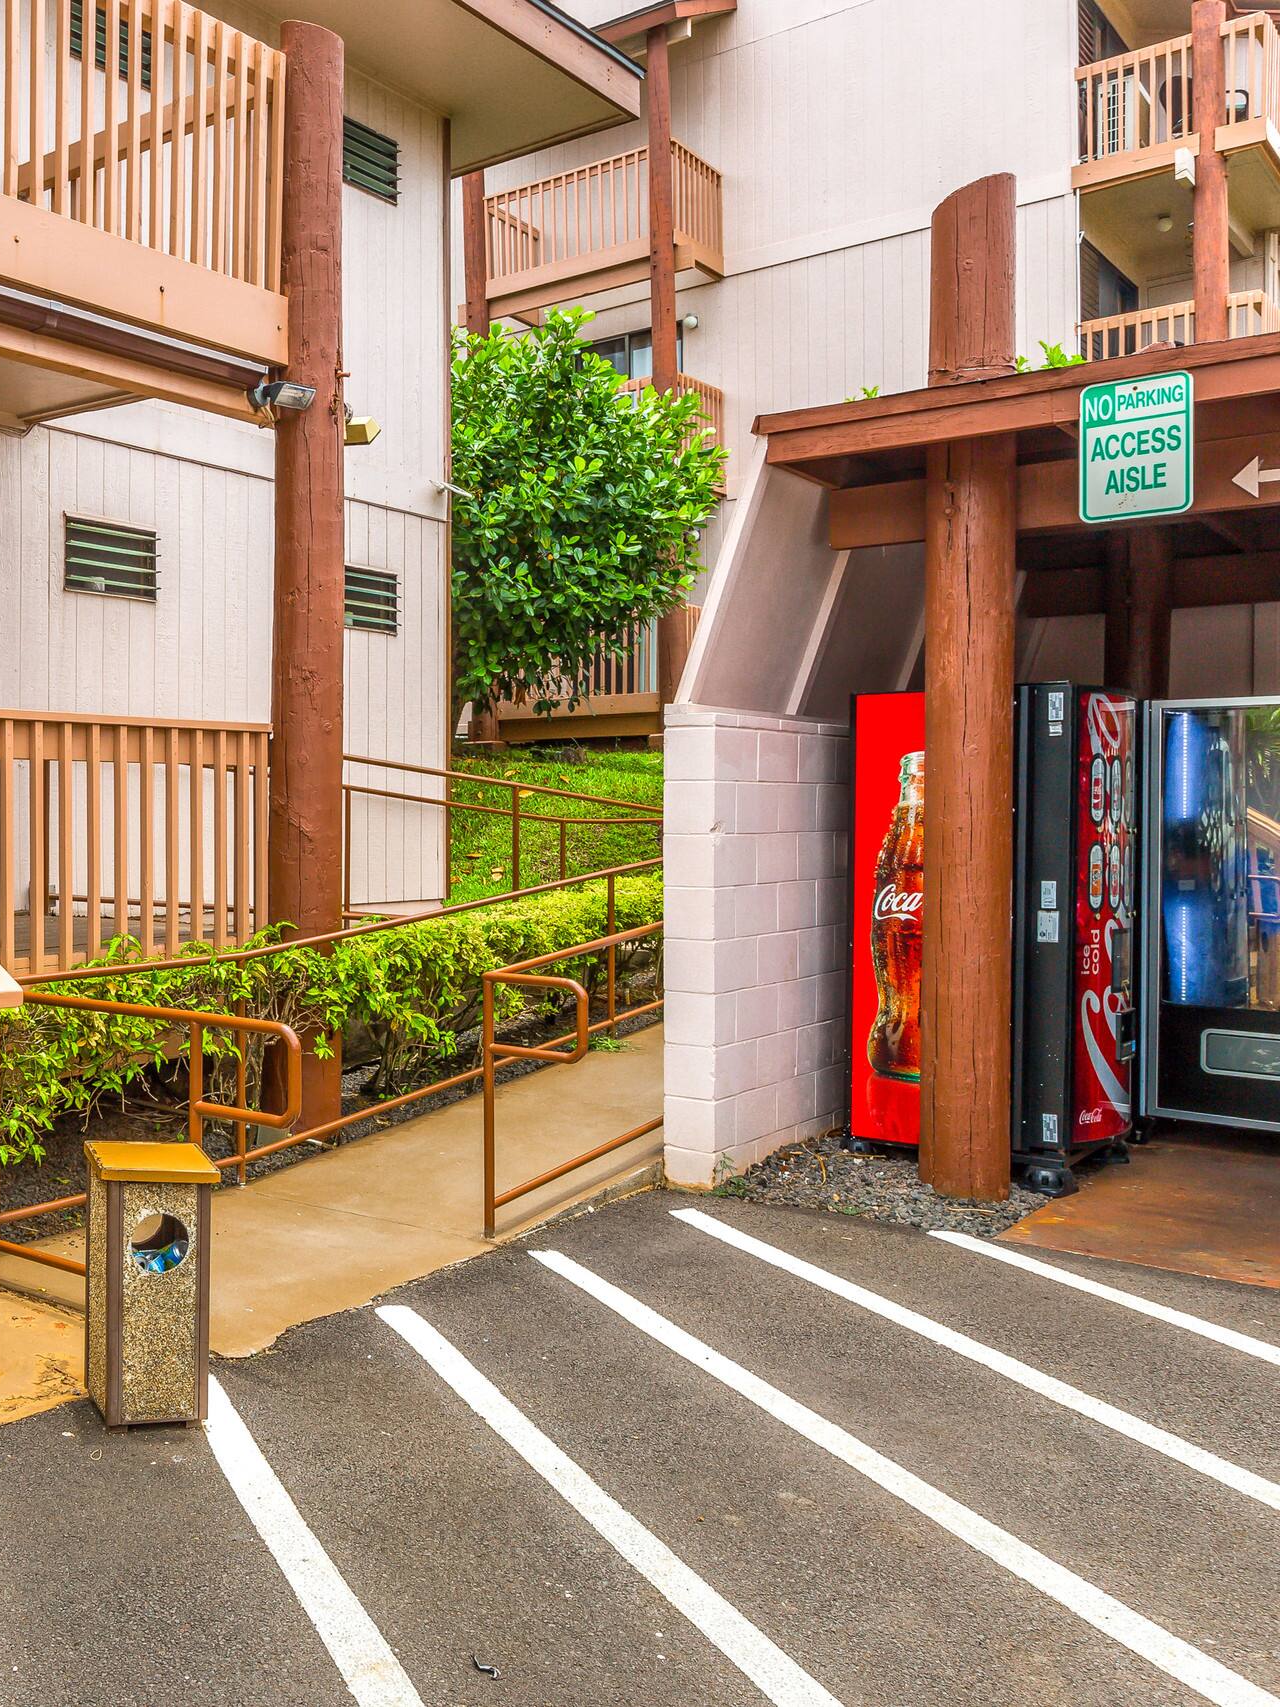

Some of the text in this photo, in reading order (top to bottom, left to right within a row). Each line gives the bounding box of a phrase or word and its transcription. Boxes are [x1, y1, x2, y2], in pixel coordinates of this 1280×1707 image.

[1085, 384, 1183, 423] NO PARKING
[1091, 425, 1182, 462] ACCESS
[1105, 463, 1167, 495] AISLE
[1081, 944, 1090, 974] ice
[1090, 930, 1100, 975] cold
